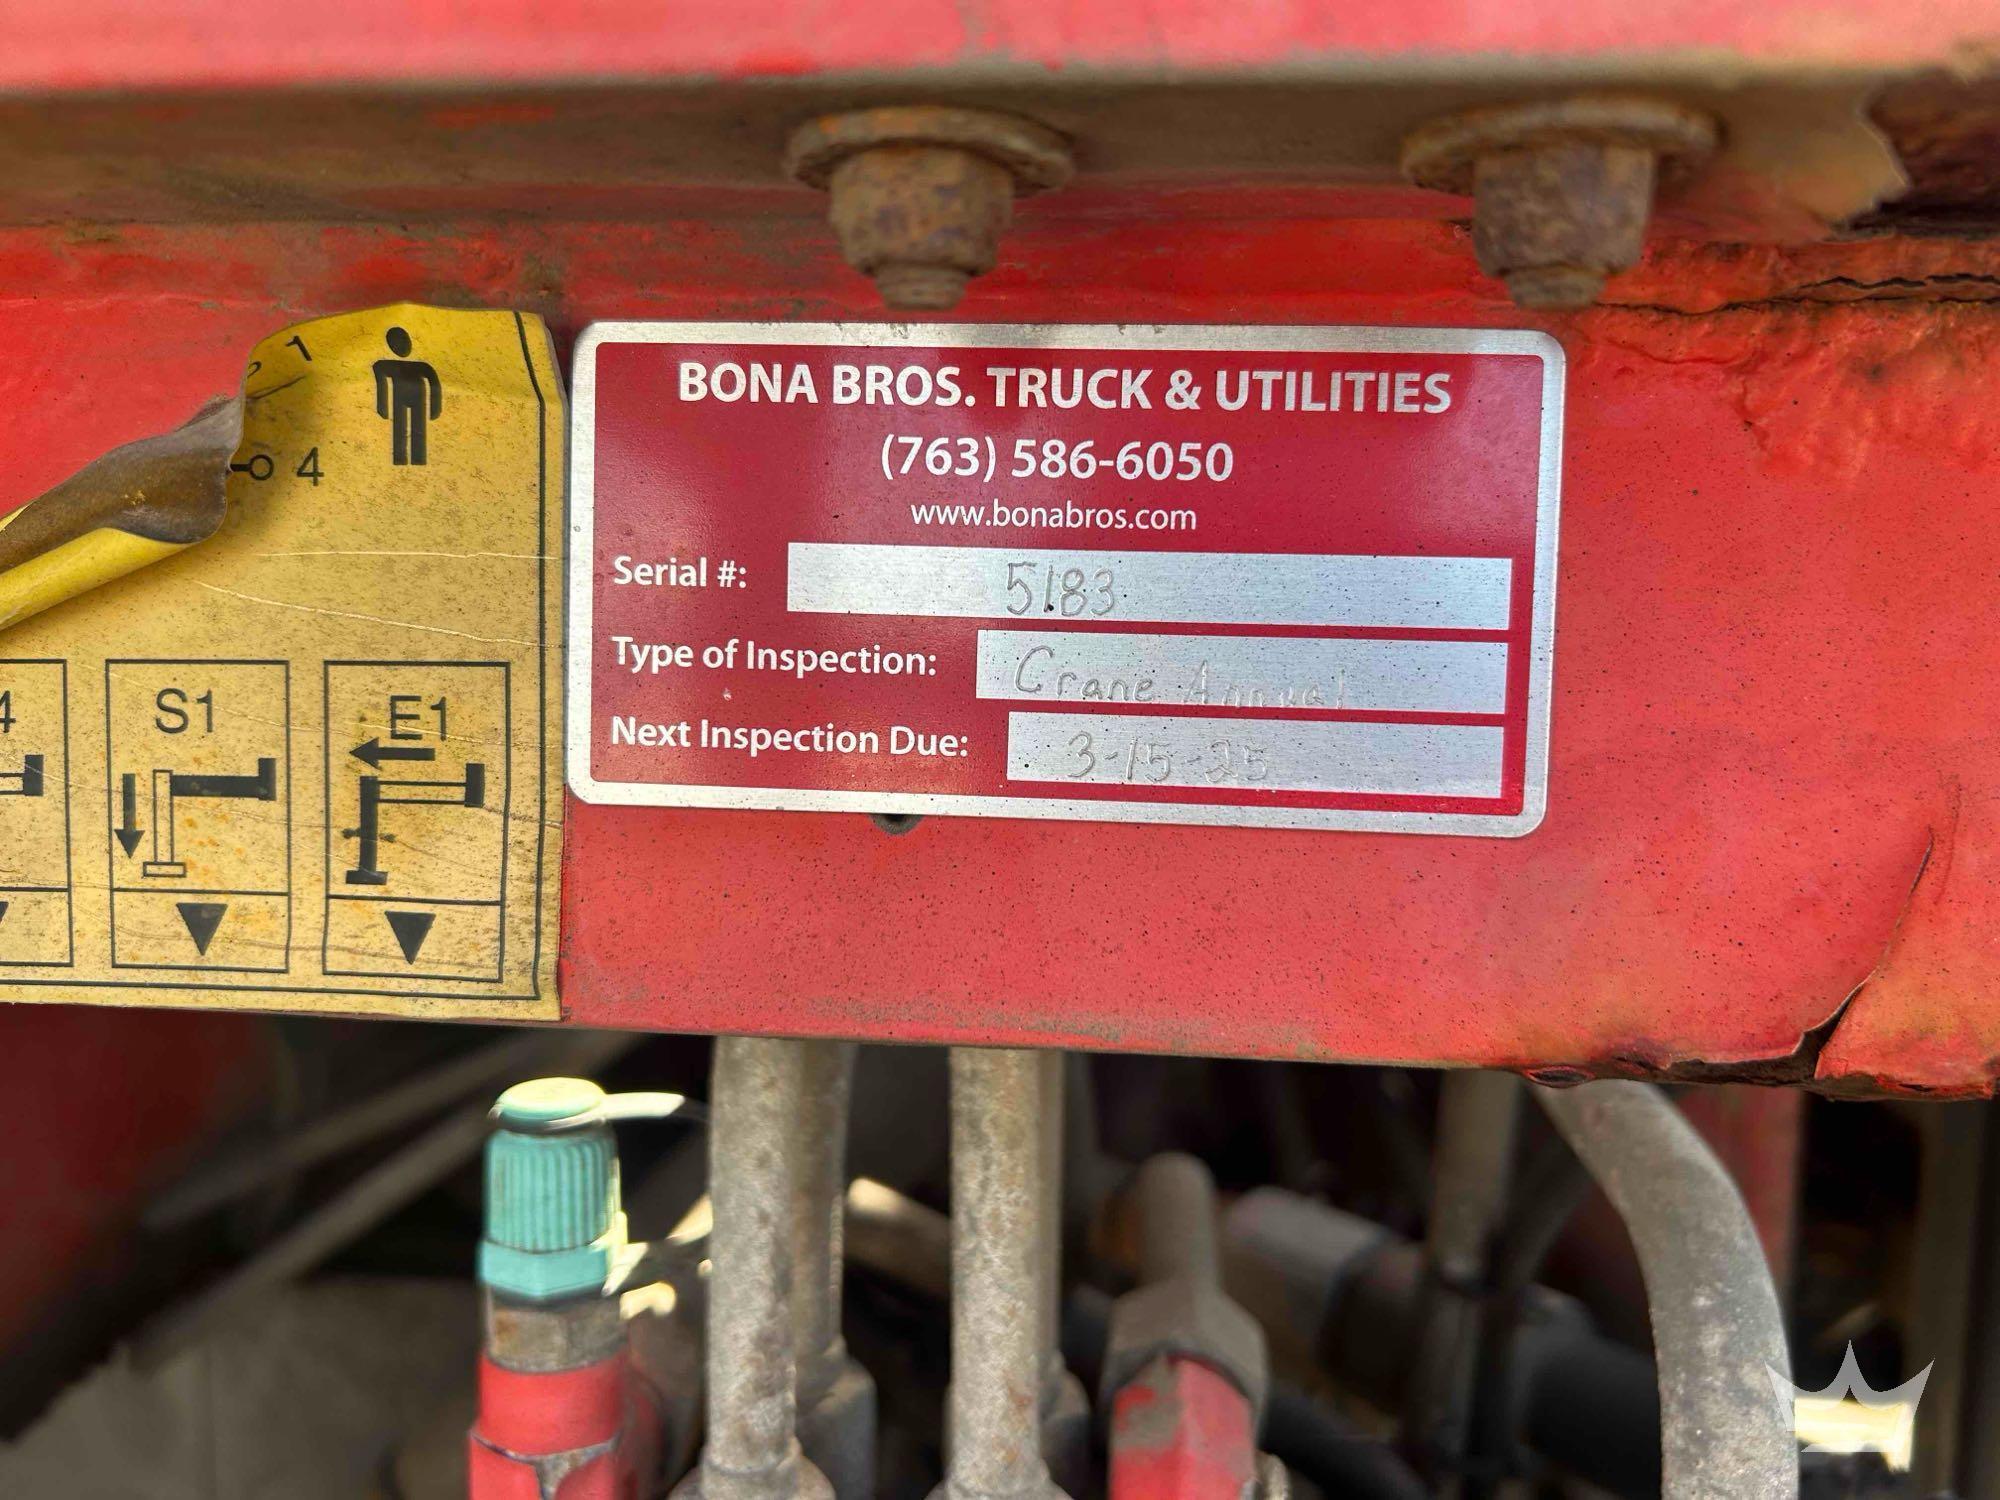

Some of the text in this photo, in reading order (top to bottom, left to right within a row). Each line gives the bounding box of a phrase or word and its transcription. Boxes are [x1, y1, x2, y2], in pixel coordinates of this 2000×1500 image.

[679, 362, 1453, 414] BONA BROS. TRUCK & UTILITIES
[296, 446, 324, 486] 4
[881, 433, 1234, 482] (763) 586-6050
[911, 499, 1197, 531] www.bonabros.com
[613, 555, 747, 588] Serial #:
[1006, 561, 1115, 617] 5183
[611, 636, 937, 678] Type of Inspection:
[1013, 645, 1154, 702] Crane
[156, 688, 213, 734] S1
[390, 695, 448, 741] E1
[611, 716, 968, 757] Next Inspection Due:
